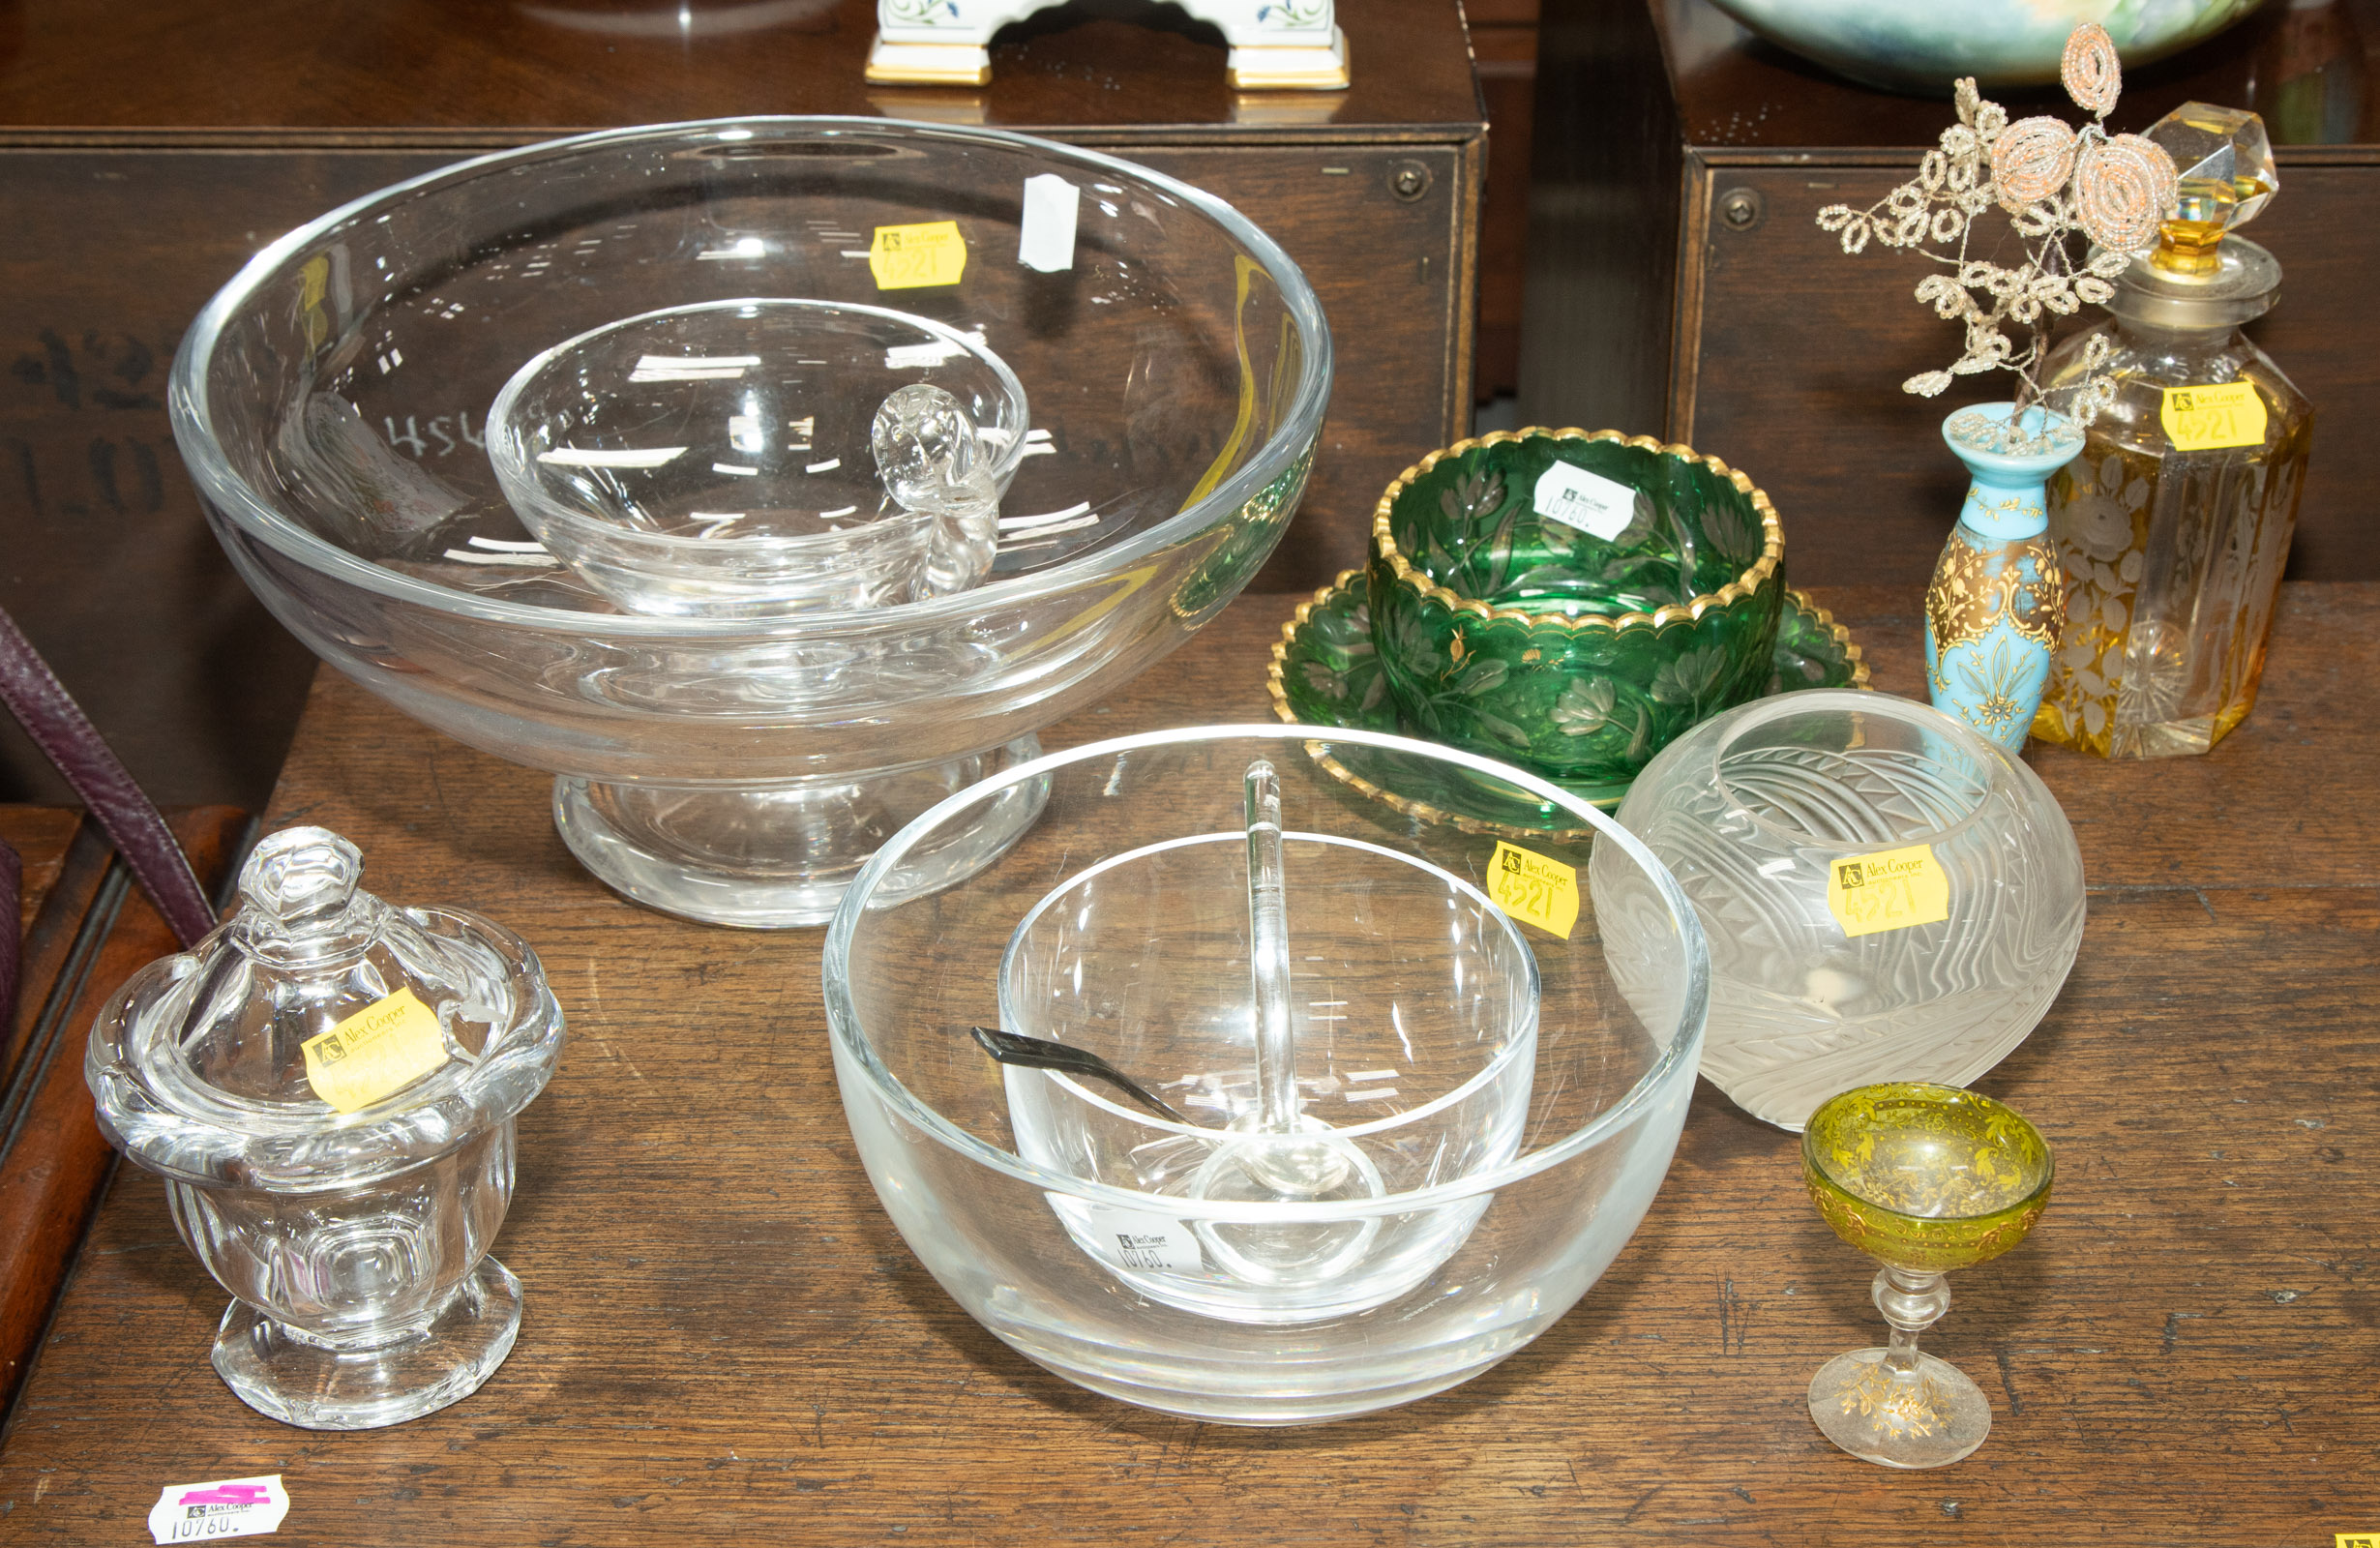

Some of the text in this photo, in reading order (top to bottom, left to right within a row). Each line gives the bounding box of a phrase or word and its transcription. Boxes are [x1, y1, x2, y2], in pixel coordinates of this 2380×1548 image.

[2177, 409, 2237, 441] 4521
[1524, 859, 1540, 875] Alex
[1541, 864, 1567, 886] Cooper
[1866, 862, 1887, 878] Alex
[1888, 858, 1923, 875] Cooper
[1498, 871, 1553, 920] 4521
[1845, 878, 1916, 923] 4521
[343, 1027, 370, 1046] Alex
[366, 1004, 406, 1031] Cooper
[207, 1503, 225, 1512] Alex
